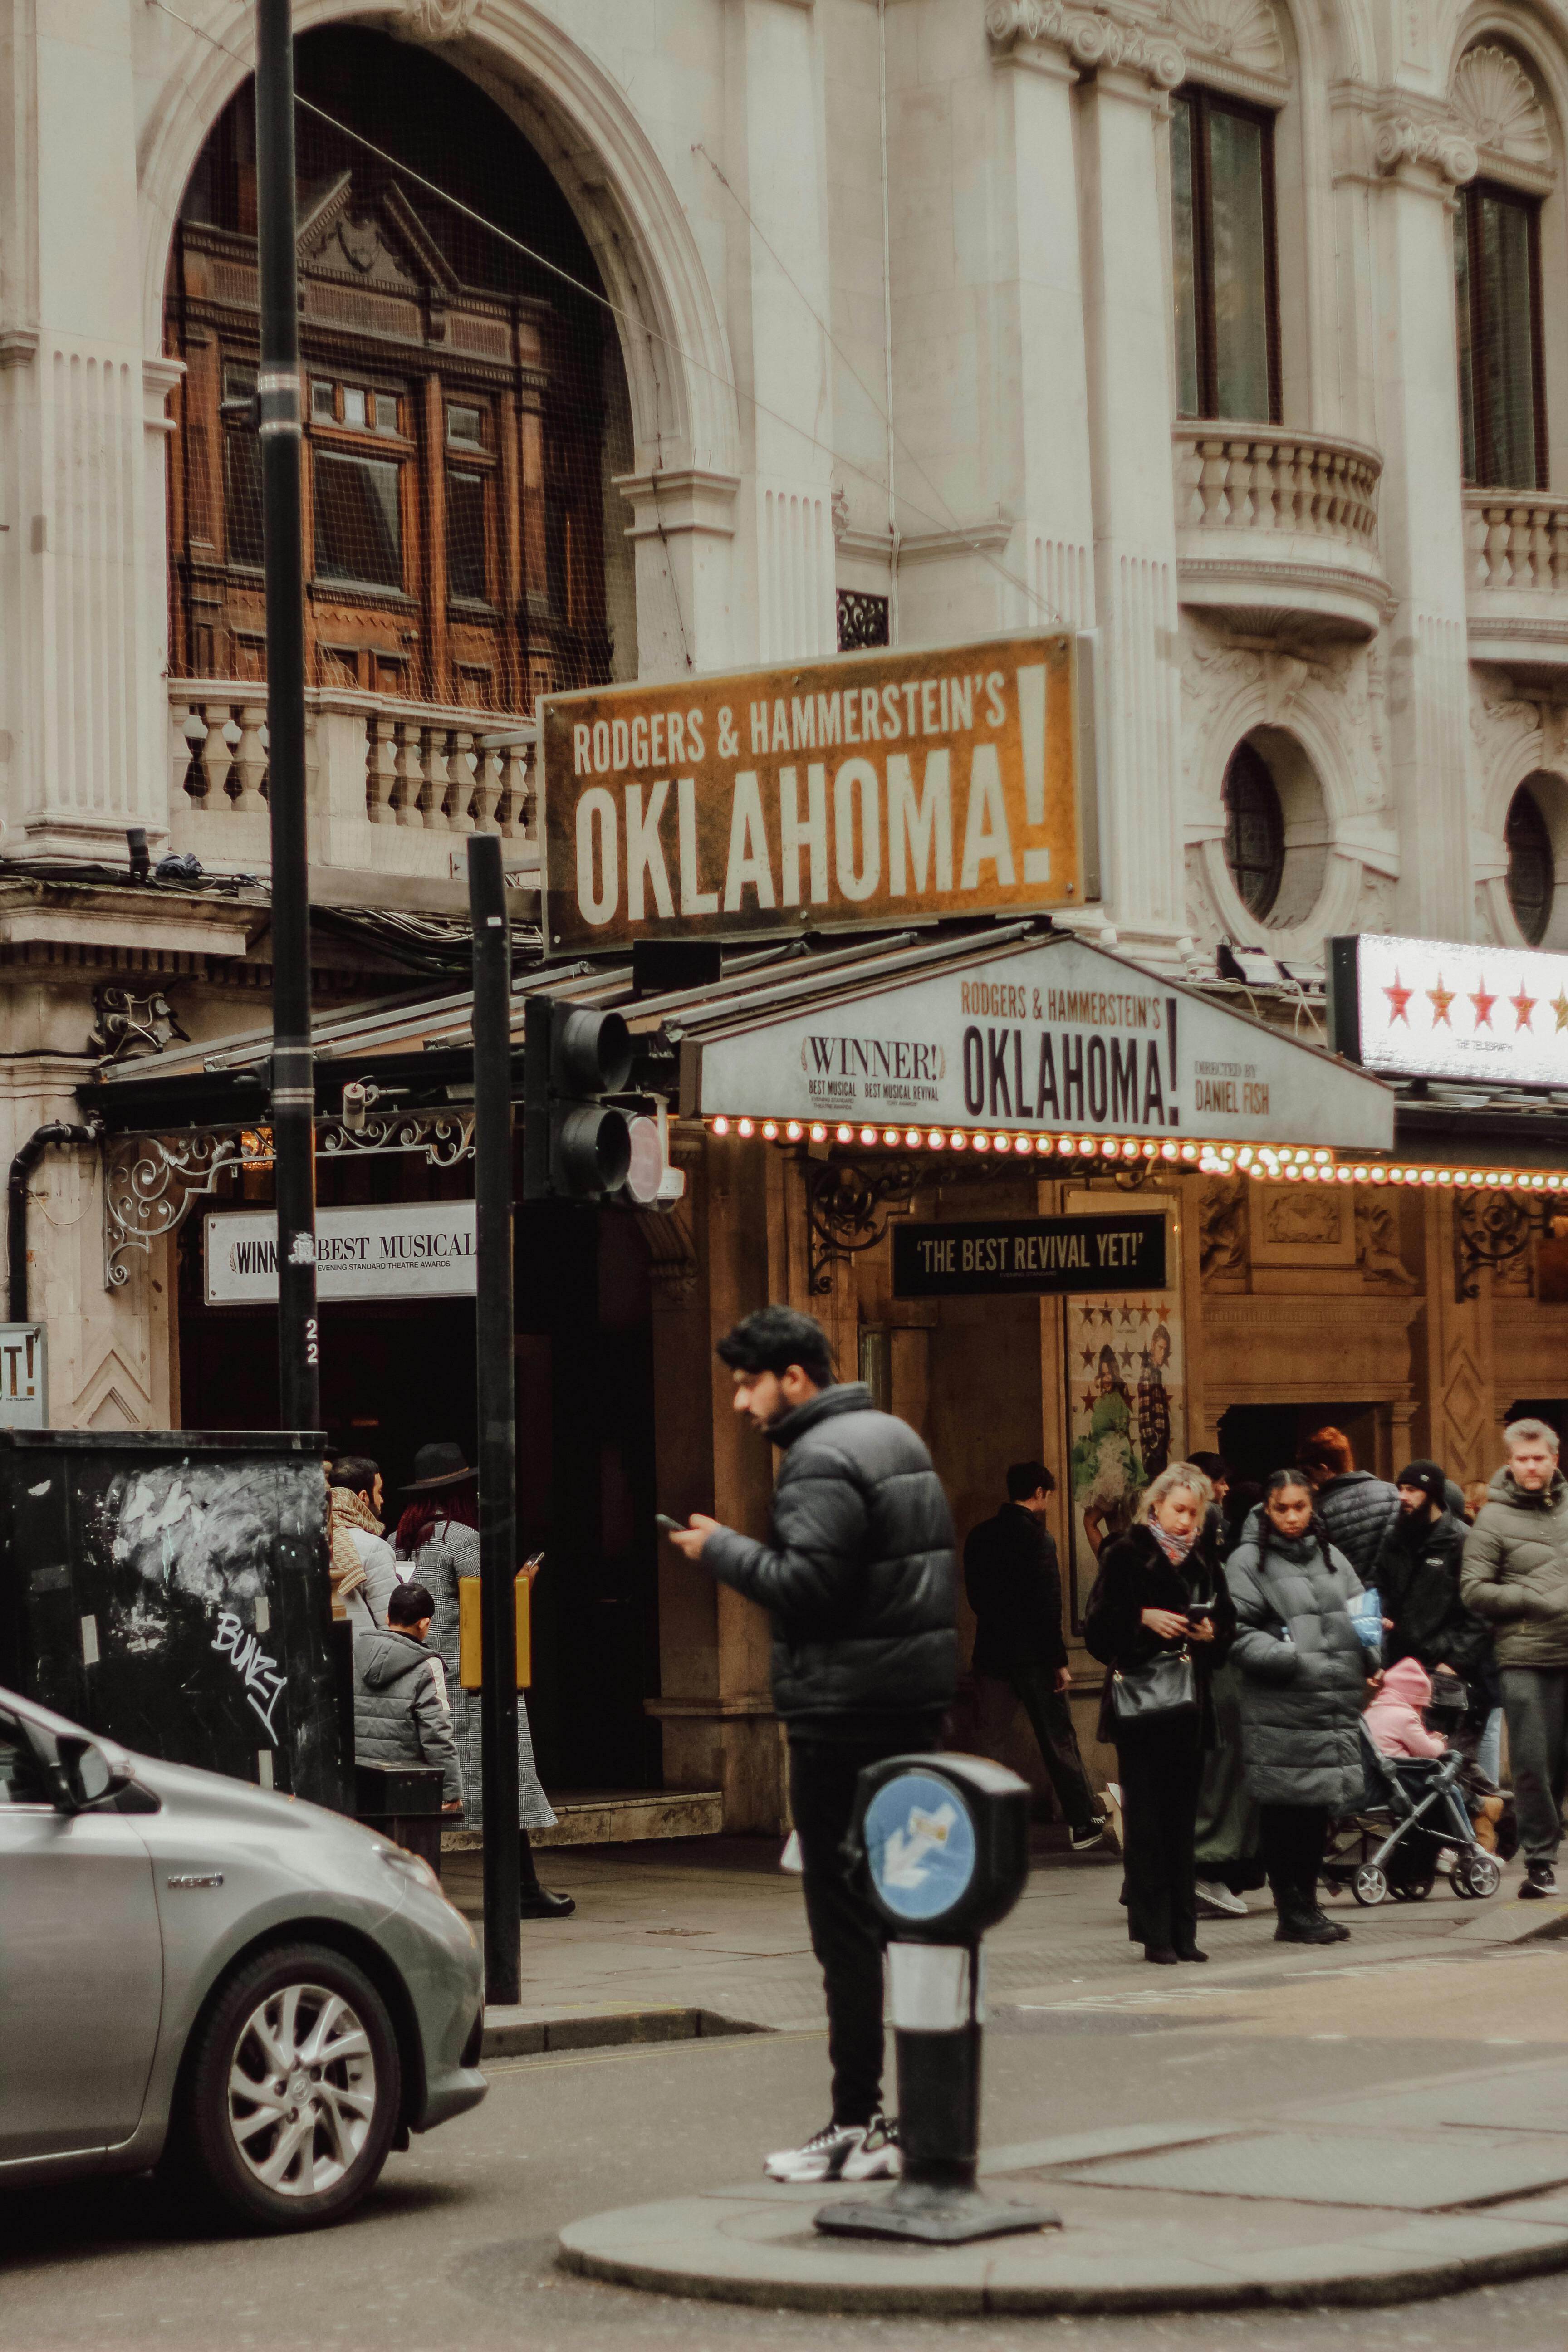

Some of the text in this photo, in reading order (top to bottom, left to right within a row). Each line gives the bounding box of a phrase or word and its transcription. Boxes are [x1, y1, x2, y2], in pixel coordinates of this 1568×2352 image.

[574, 671, 1005, 775] RODGERS & HAMMERSTEIN'S
[575, 664, 1050, 926] OKLAHOMA!
[961, 981, 1161, 1029] RODGERS & HAMMERSTEIN'S
[808, 1036, 937, 1081] WINNER!
[962, 997, 1179, 1126] OKLAHOMA!
[809, 1079, 857, 1097] BEST MUSICAL
[864, 1083, 939, 1101] BEST MUSICAL REVIVAL
[1195, 1079, 1269, 1115] DANIEL FISH
[316, 1237, 370, 1261] BEST
[379, 1233, 477, 1259] MUSICAL
[348, 1263, 386, 1271] STANDARD
[387, 1261, 419, 1269] THEATRE
[420, 1260, 451, 1268] AWARDS
[962, 1237, 1009, 1272] BEST
[1014, 1234, 1090, 1270] REVIVAL
[0, 1334, 35, 1396] T!
